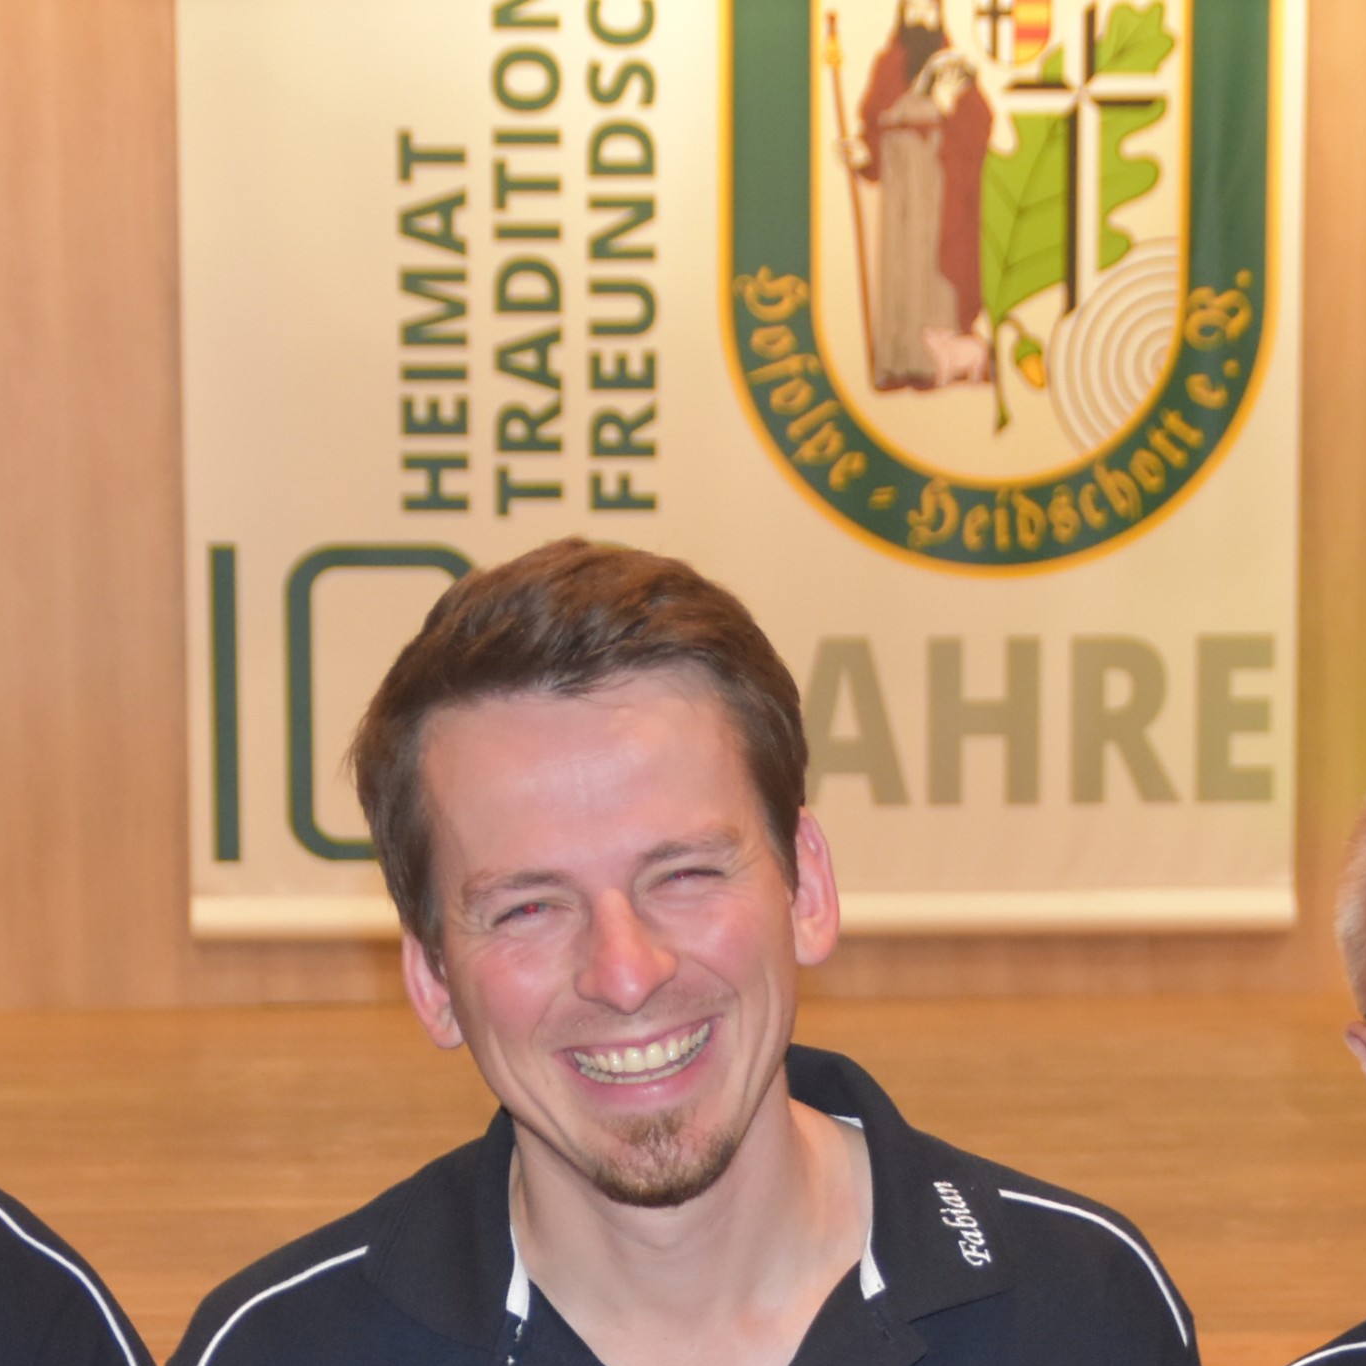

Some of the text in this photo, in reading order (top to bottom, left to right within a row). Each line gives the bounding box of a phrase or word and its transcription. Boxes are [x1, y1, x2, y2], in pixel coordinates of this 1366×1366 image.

[397, 127, 470, 513] HEIMAT
[906, 406, 1205, 553] Heidschott
[798, 632, 1277, 808] AHRE
[932, 1180, 993, 1267] Fabian
